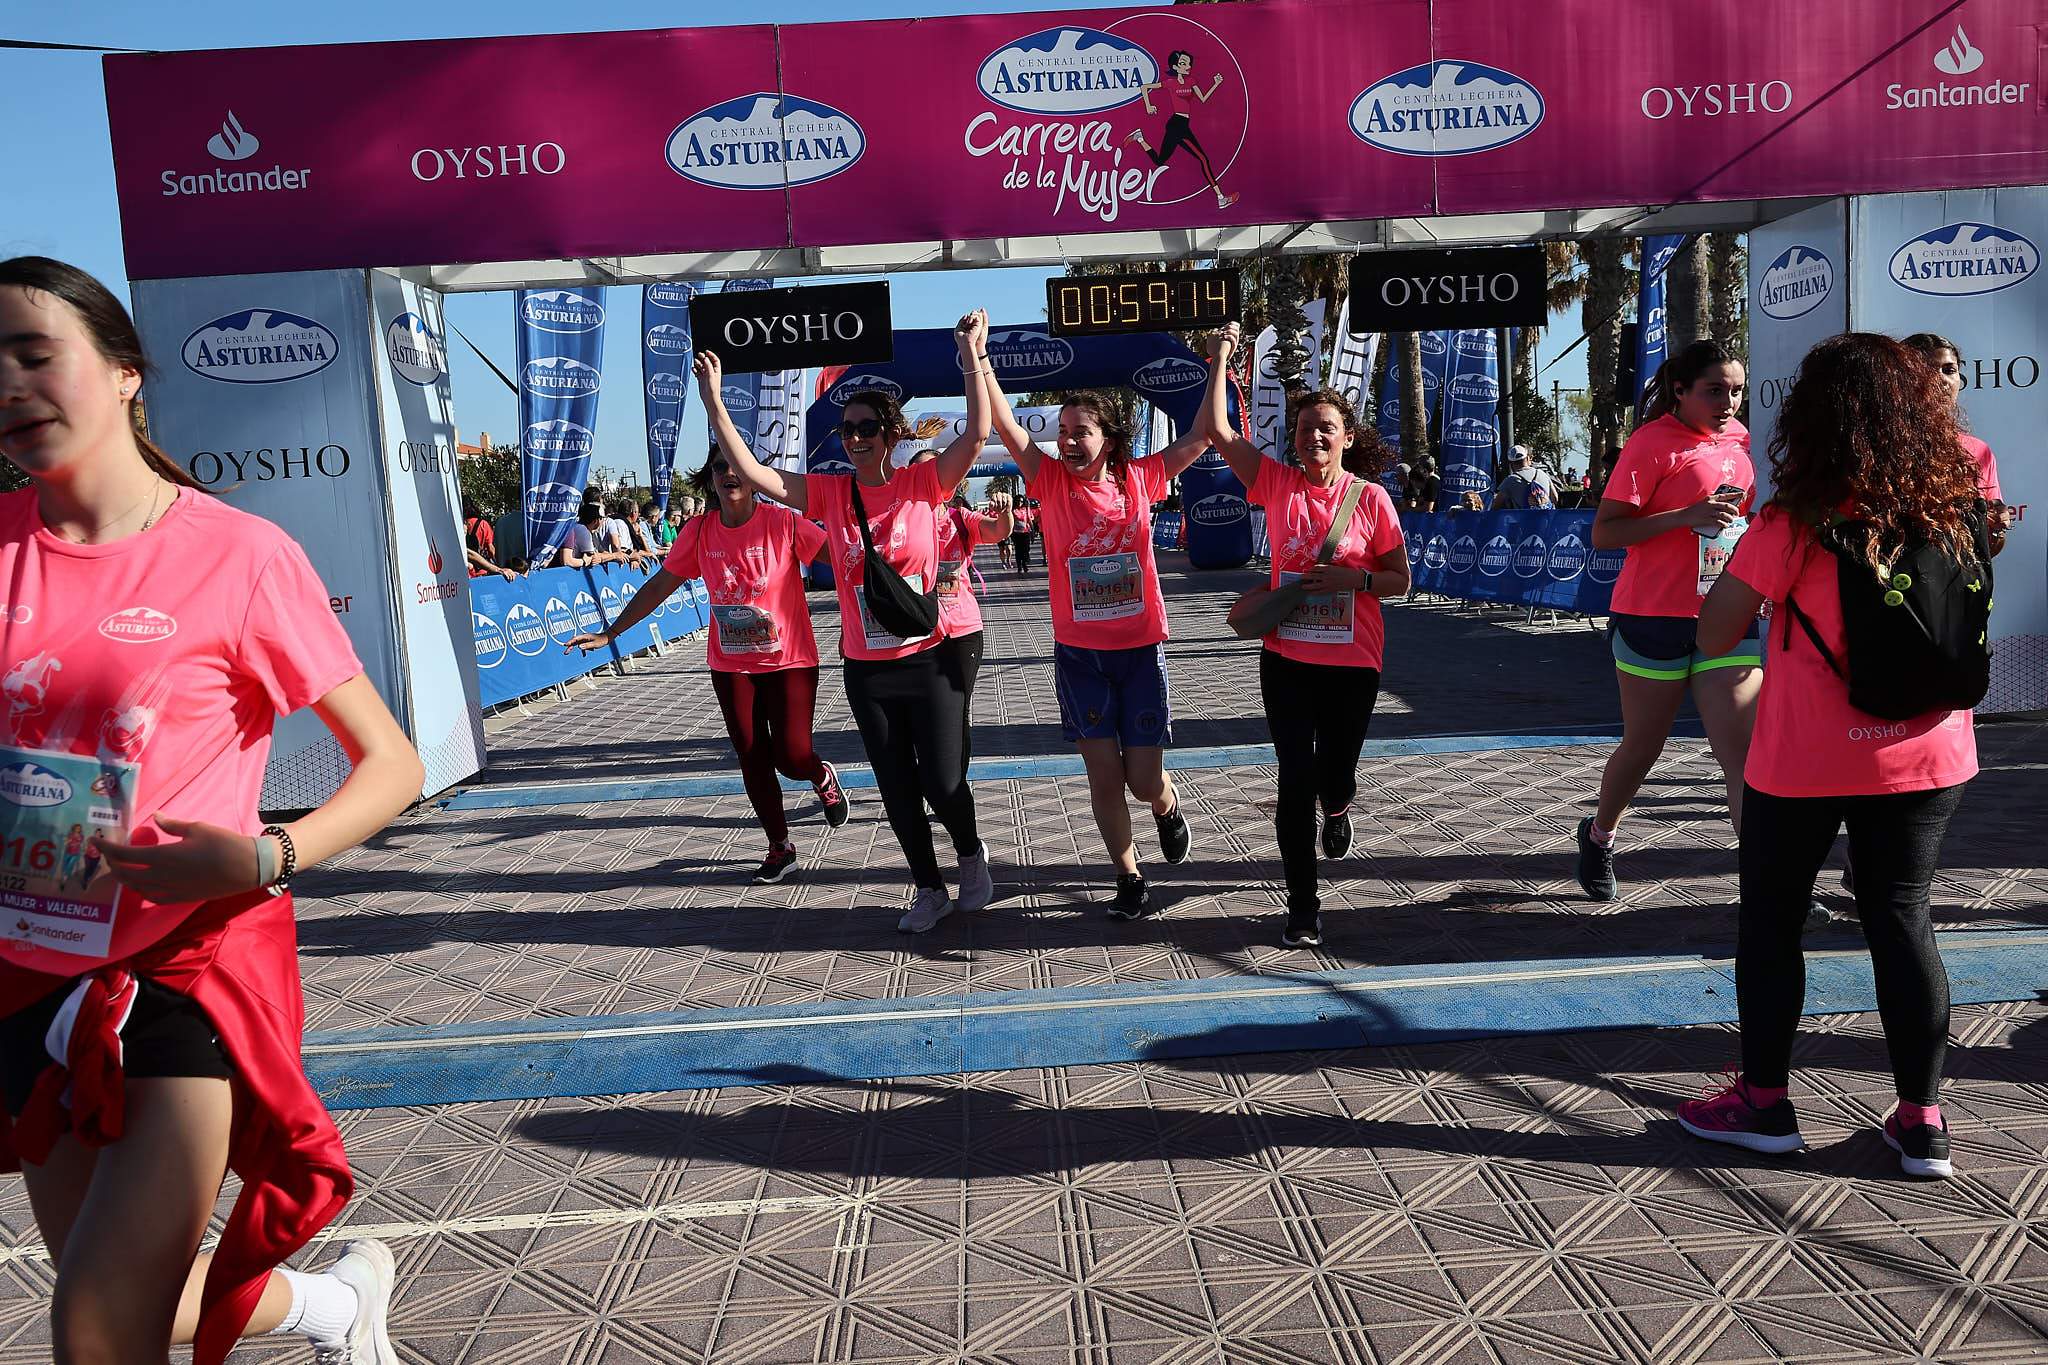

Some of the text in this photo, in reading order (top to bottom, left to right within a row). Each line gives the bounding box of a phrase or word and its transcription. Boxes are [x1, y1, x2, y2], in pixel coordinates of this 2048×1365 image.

[1018, 54, 1139, 67] CENTRAL LECHERA
[991, 61, 1144, 94] ASTURIANA
[1393, 89, 1523, 105] CENTRAL LECHERA
[1640, 79, 1793, 120] OYSHO
[1885, 78, 2030, 111] Santander
[1364, 98, 1530, 133] ASTURIANA
[710, 126, 773, 139] CENTRAL
[964, 111, 1114, 157] Carrera
[410, 140, 567, 182] OYSHO
[681, 131, 851, 168] ASTURIANA
[160, 163, 312, 197] Santander
[1002, 147, 1169, 222] de la Mujer
[1899, 252, 2029, 281] ASTURIANA
[1923, 245, 2024, 258] CENTRAL LECHERA
[1060, 279, 1227, 327] 00:59:14
[1381, 272, 1519, 307] OYSHO
[1762, 273, 1828, 307] ASTURIANA
[524, 302, 599, 324] ASTURIANA
[216, 331, 321, 345] CENTRAL LECHERA
[724, 311, 864, 348] OYSHO
[195, 338, 328, 369] ASTURIANA
[526, 371, 597, 389] ASTURIANA
[1139, 370, 1203, 387] ASTURIANA
[399, 440, 452, 475] OYSHO
[526, 437, 591, 452] ASTURIANA
[899, 442, 928, 450] OYSHO
[189, 443, 351, 485] OYSHO
[416, 580, 459, 605] Santander
[104, 618, 170, 635] ASTURIANA
[1849, 723, 1907, 741] OYSHO
[46, 901, 100, 919] VALENCIA
